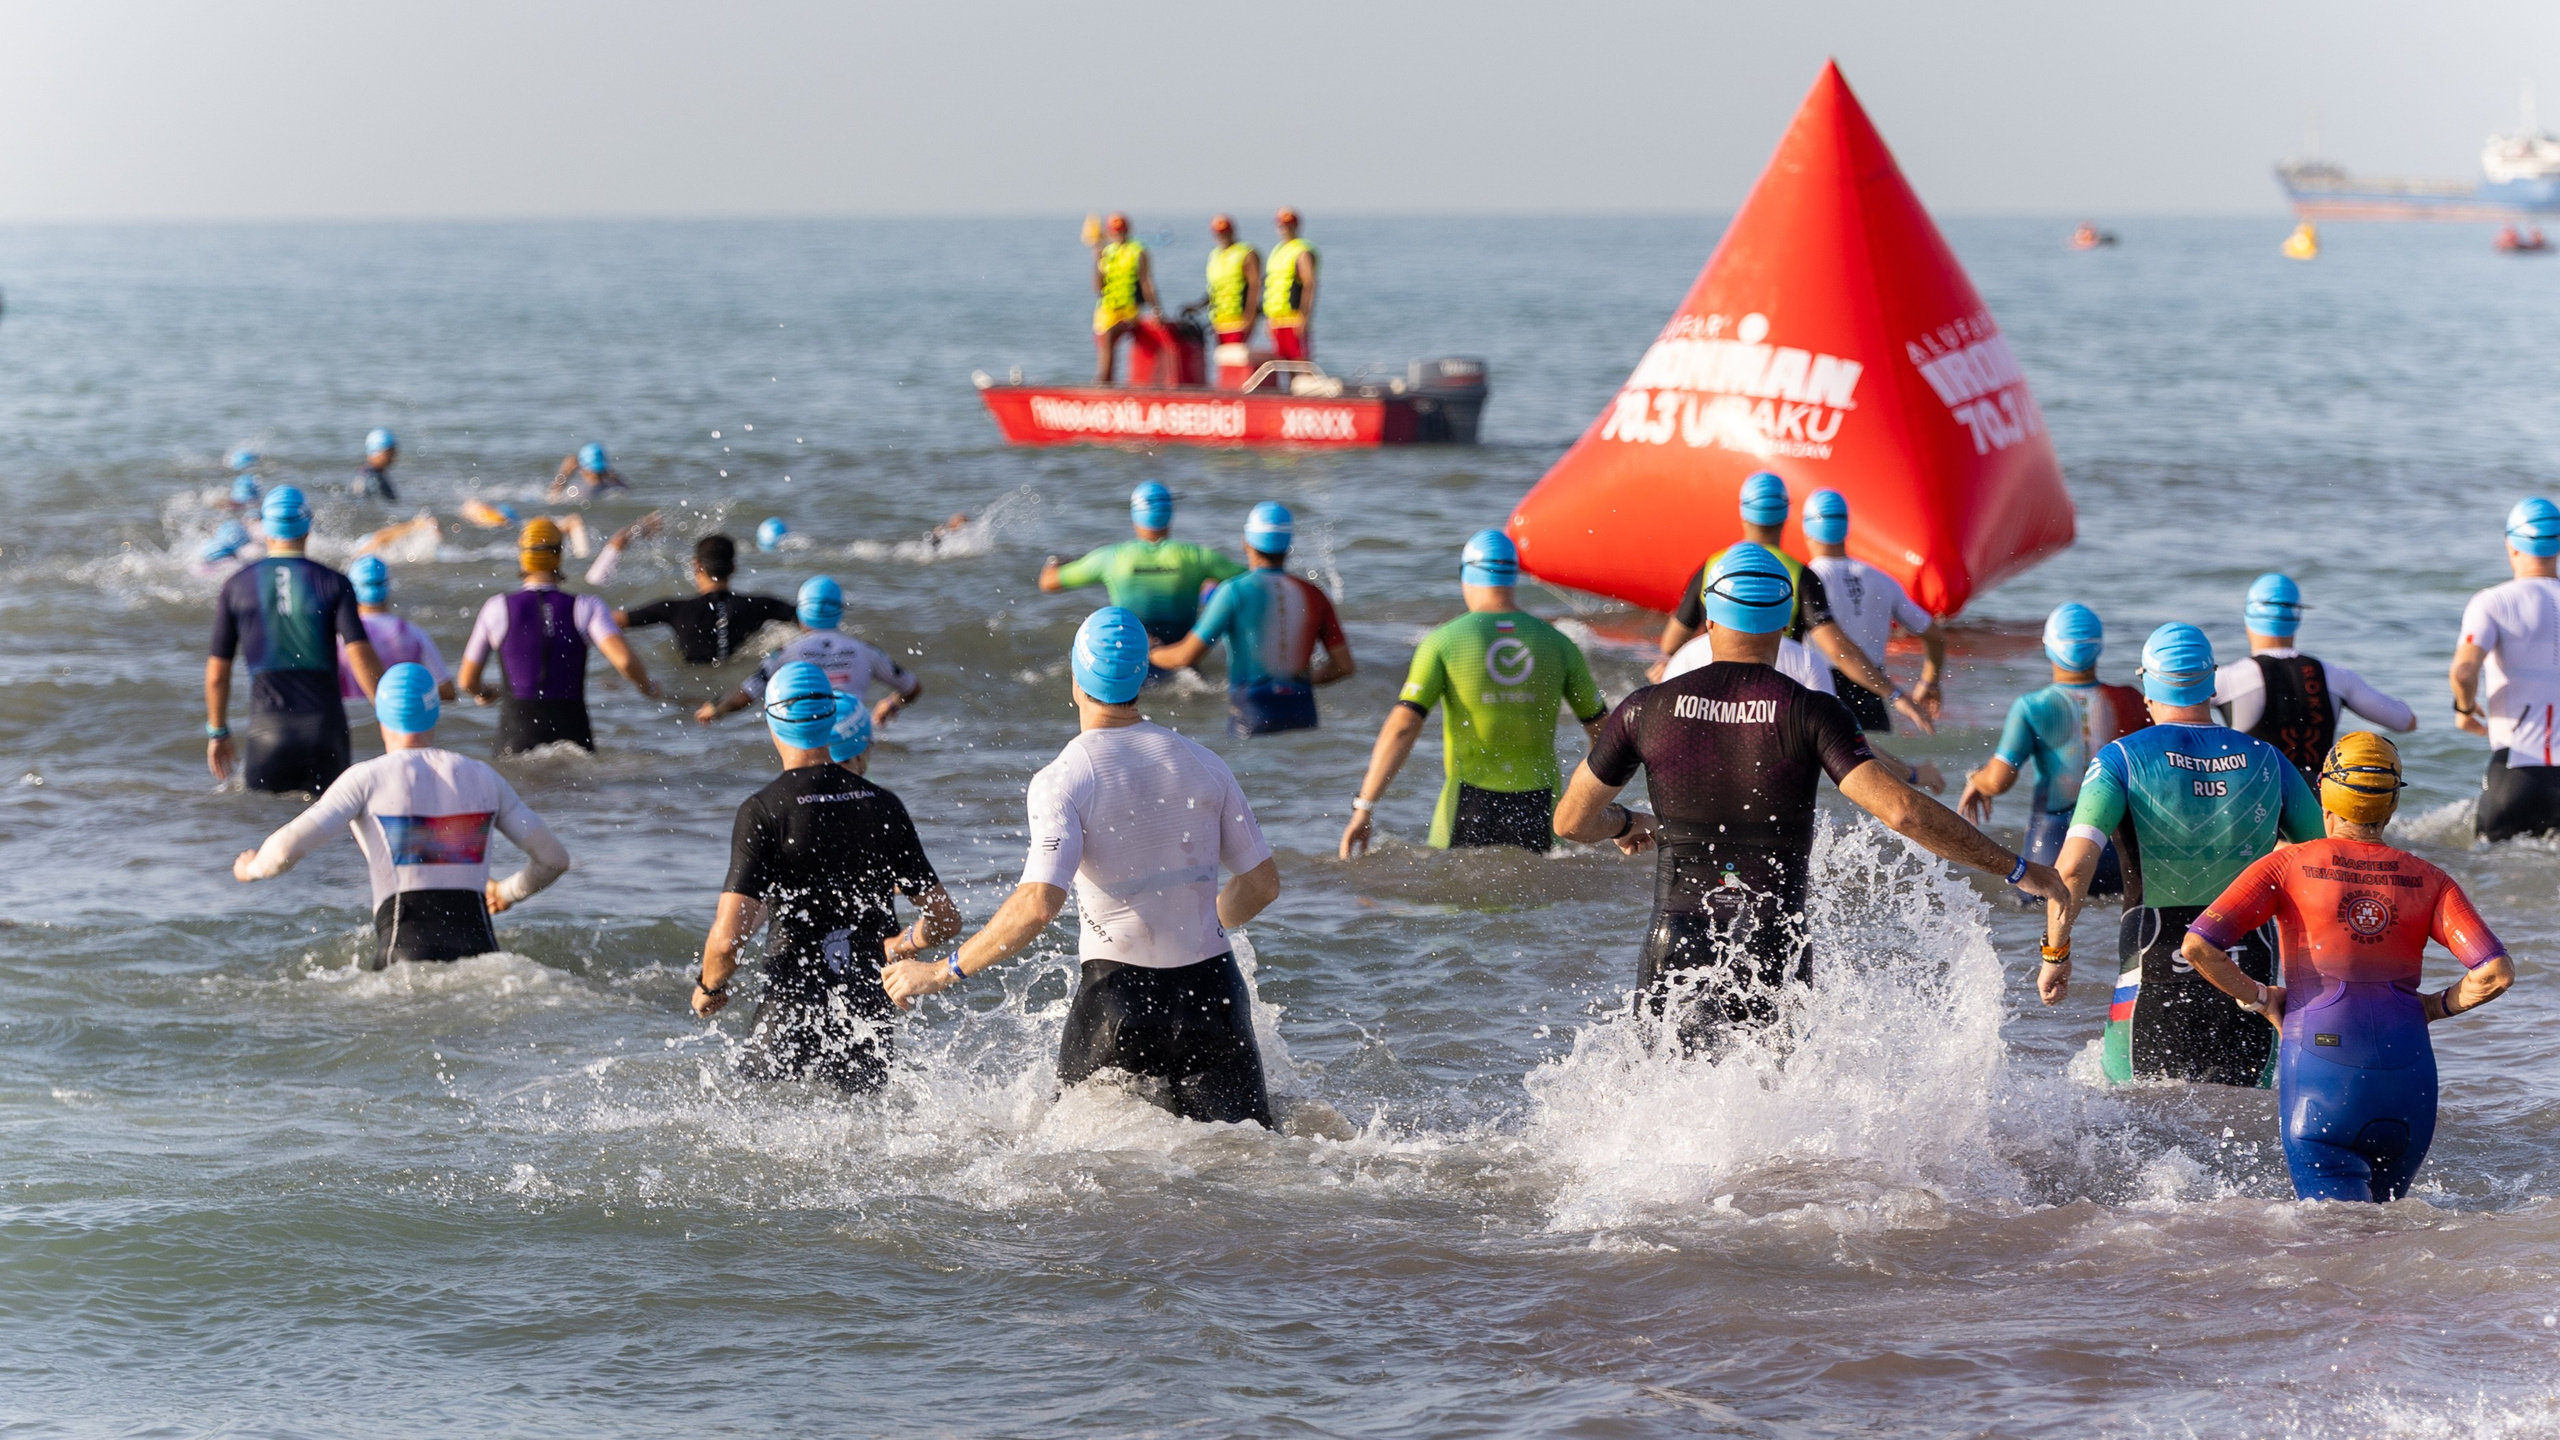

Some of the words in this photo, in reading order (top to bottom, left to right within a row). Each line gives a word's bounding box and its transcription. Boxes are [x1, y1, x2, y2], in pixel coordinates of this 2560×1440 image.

[1674, 694, 1777, 724] KORKMAZOV
[2165, 751, 2247, 774] TRETYAKOV
[2192, 780, 2228, 797] RUS
[2331, 854, 2400, 872] MASTERS
[2302, 865, 2388, 886] TRIATHLON
[2389, 874, 2424, 888] TEAM
